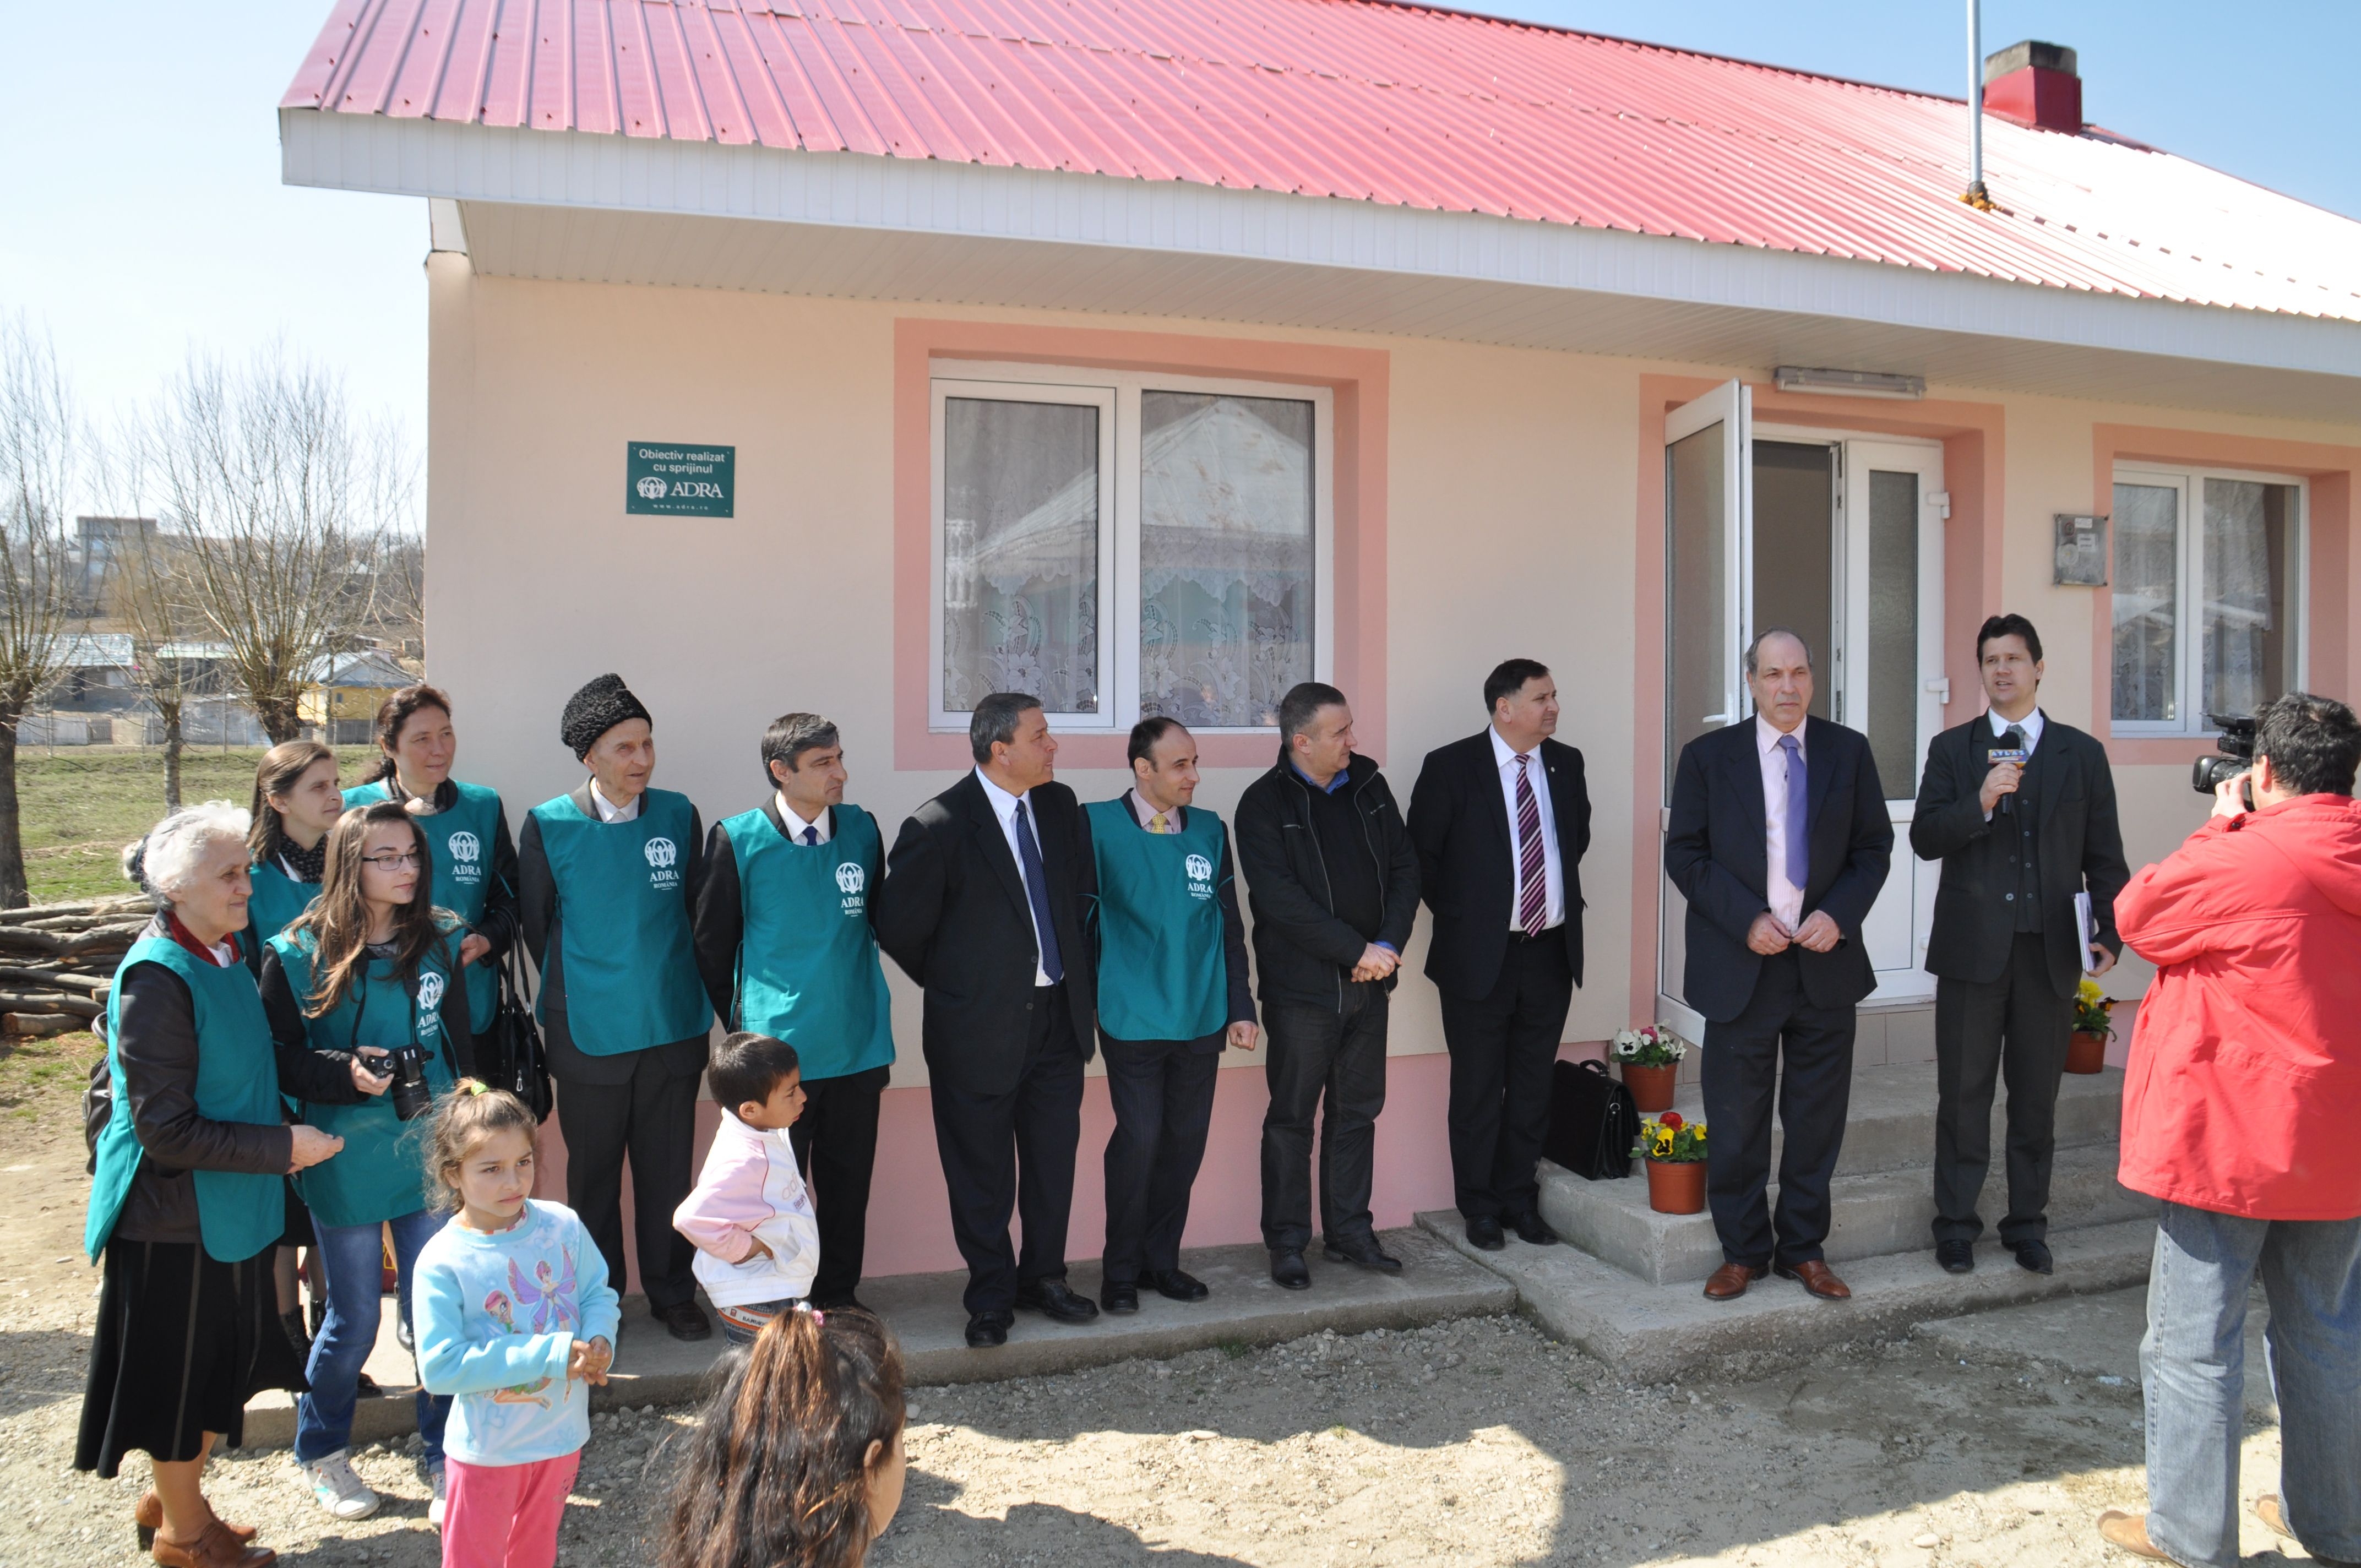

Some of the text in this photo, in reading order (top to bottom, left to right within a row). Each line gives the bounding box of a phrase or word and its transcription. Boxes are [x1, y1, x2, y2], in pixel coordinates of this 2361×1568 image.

[639, 449, 725, 462] Obiectiv realizat
[653, 463, 713, 475] cu sprijinul
[670, 481, 723, 498] ADRA
[451, 865, 481, 875] ADRA
[650, 870, 679, 881] ADRA
[1188, 882, 1212, 894] ADRA
[841, 896, 863, 907] ADRA
